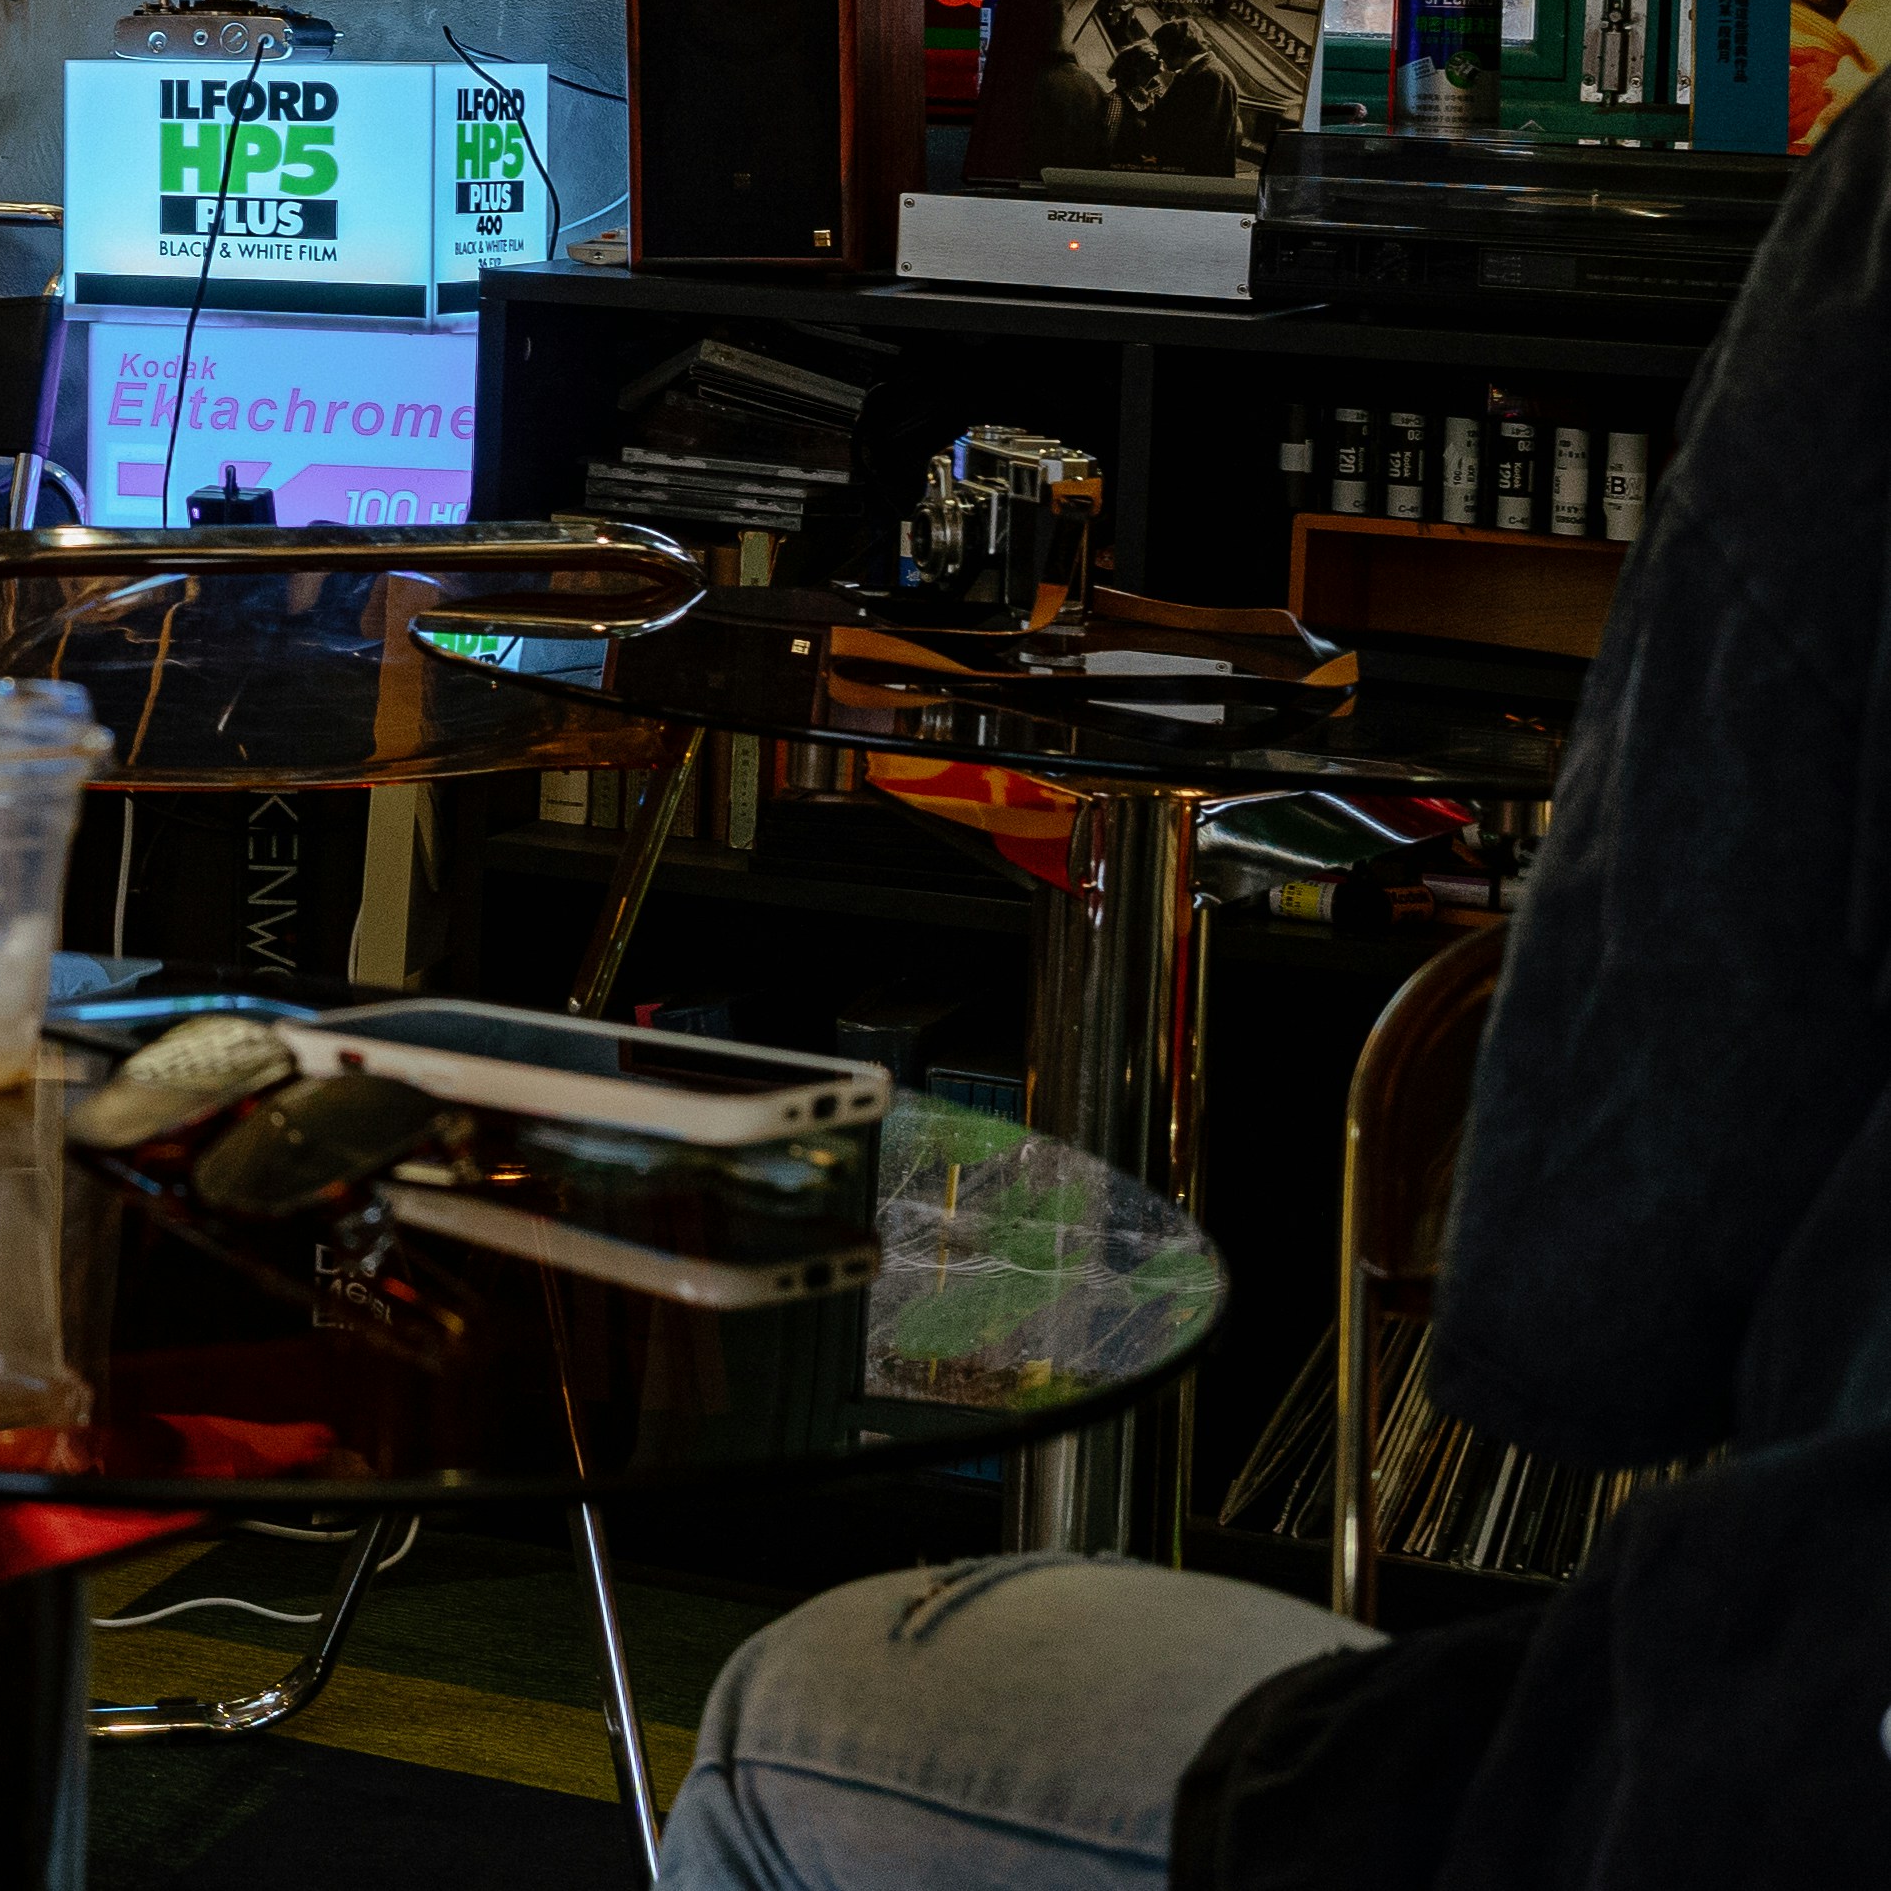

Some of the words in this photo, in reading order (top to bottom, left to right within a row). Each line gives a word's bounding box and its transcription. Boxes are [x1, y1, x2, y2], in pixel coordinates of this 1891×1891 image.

[159, 79, 340, 122] ILFORD
[456, 87, 526, 123] ILFORD
[159, 122, 339, 196] HP5
[455, 122, 525, 181] HP5
[468, 182, 512, 212] PLUS
[196, 197, 304, 237] PLUS
[475, 214, 503, 236] 400
[219, 243, 232, 260] &
[238, 243, 295, 262] WHITE
[298, 243, 338, 263] FILM
[454, 241, 477, 256] BLACK
[485, 239, 508, 253] WHITE
[509, 238, 525, 252] FILM
[118, 352, 218, 382] Kodak
[107, 380, 476, 441] Ektachrome
[1338, 446, 1357, 474] 120
[1387, 449, 1402, 479] 120
[1498, 461, 1513, 490] 120
[1513, 461, 1523, 491] Kodak
[345, 487, 419, 527] 100
[246, 789, 298, 977] KENW
